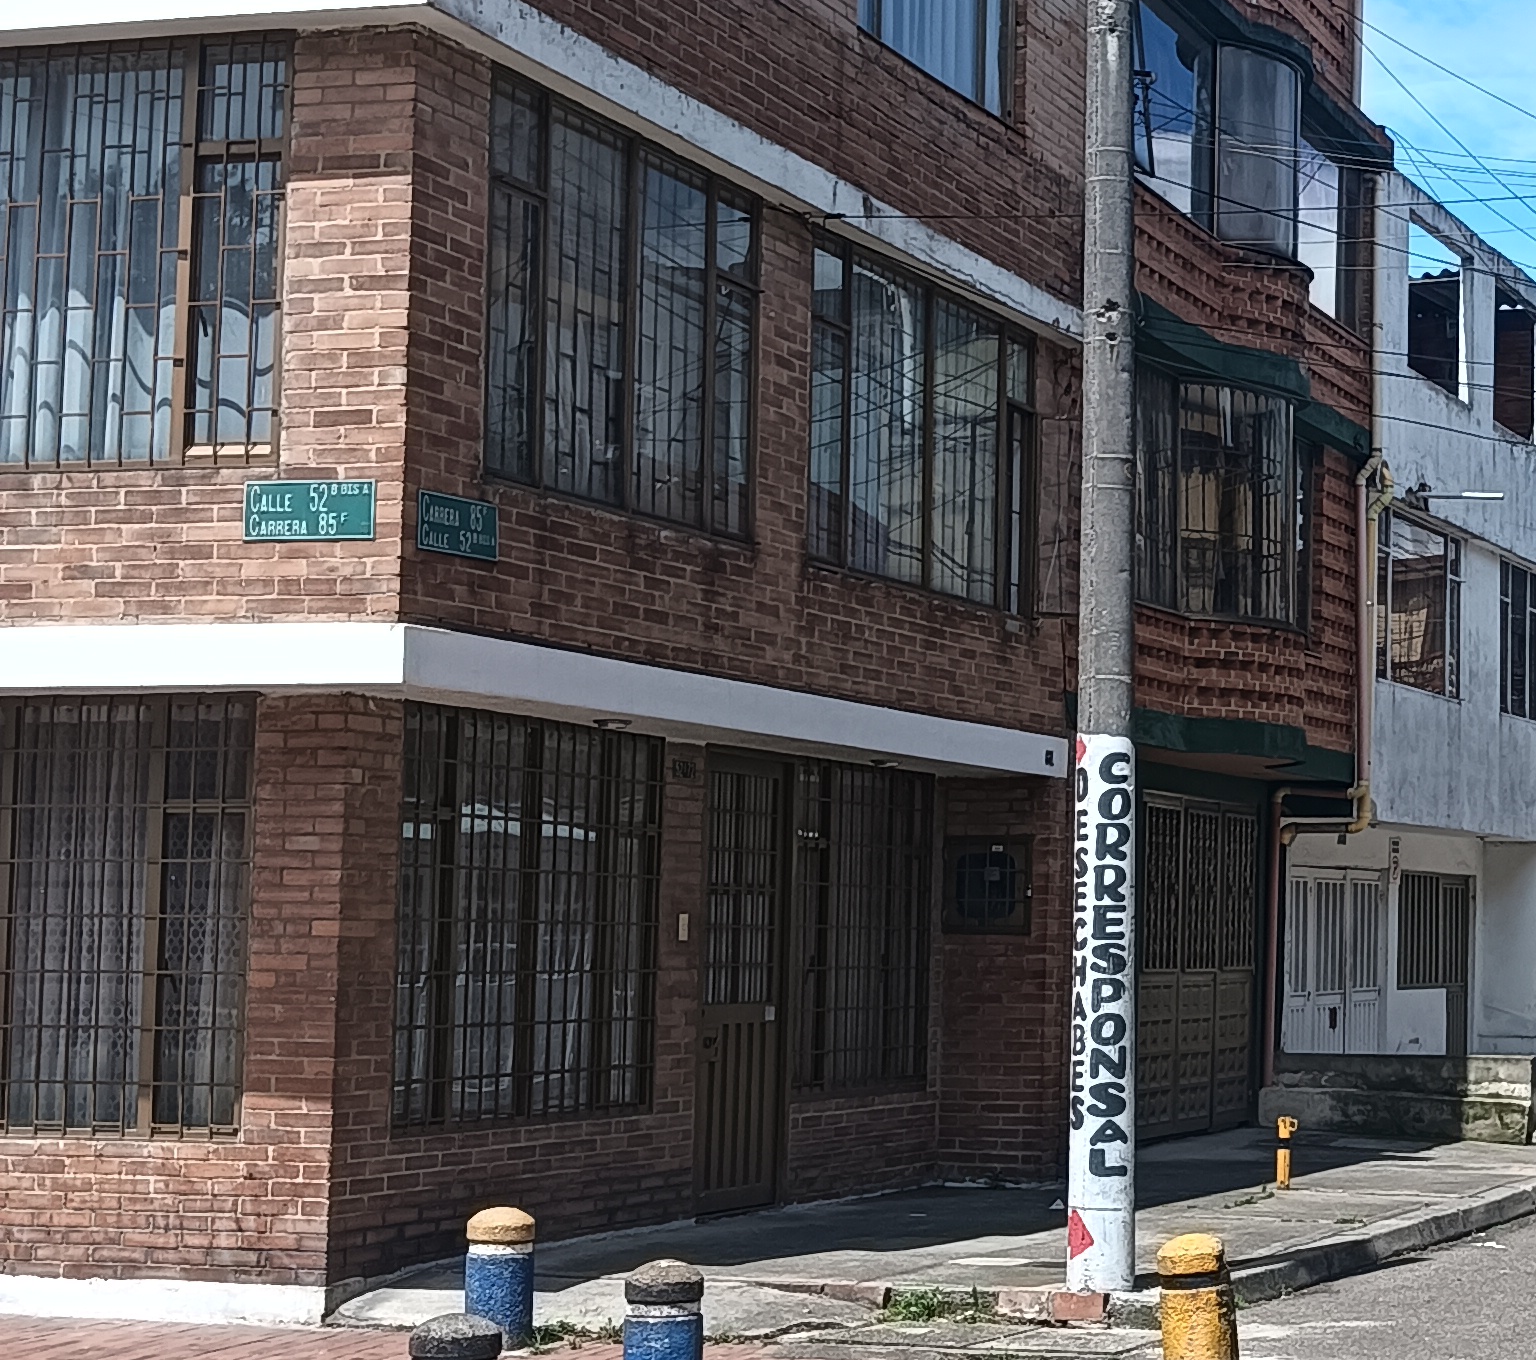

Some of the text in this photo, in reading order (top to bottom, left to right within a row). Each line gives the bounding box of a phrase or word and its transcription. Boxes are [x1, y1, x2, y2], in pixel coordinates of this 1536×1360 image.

[250, 485, 293, 512] CALLE
[362, 483, 370, 495] A
[422, 494, 460, 527] CARRERA
[249, 514, 308, 536] CARRERA
[421, 523, 450, 549] CALLE
[1087, 751, 1132, 1178] CORRESPONSAL
